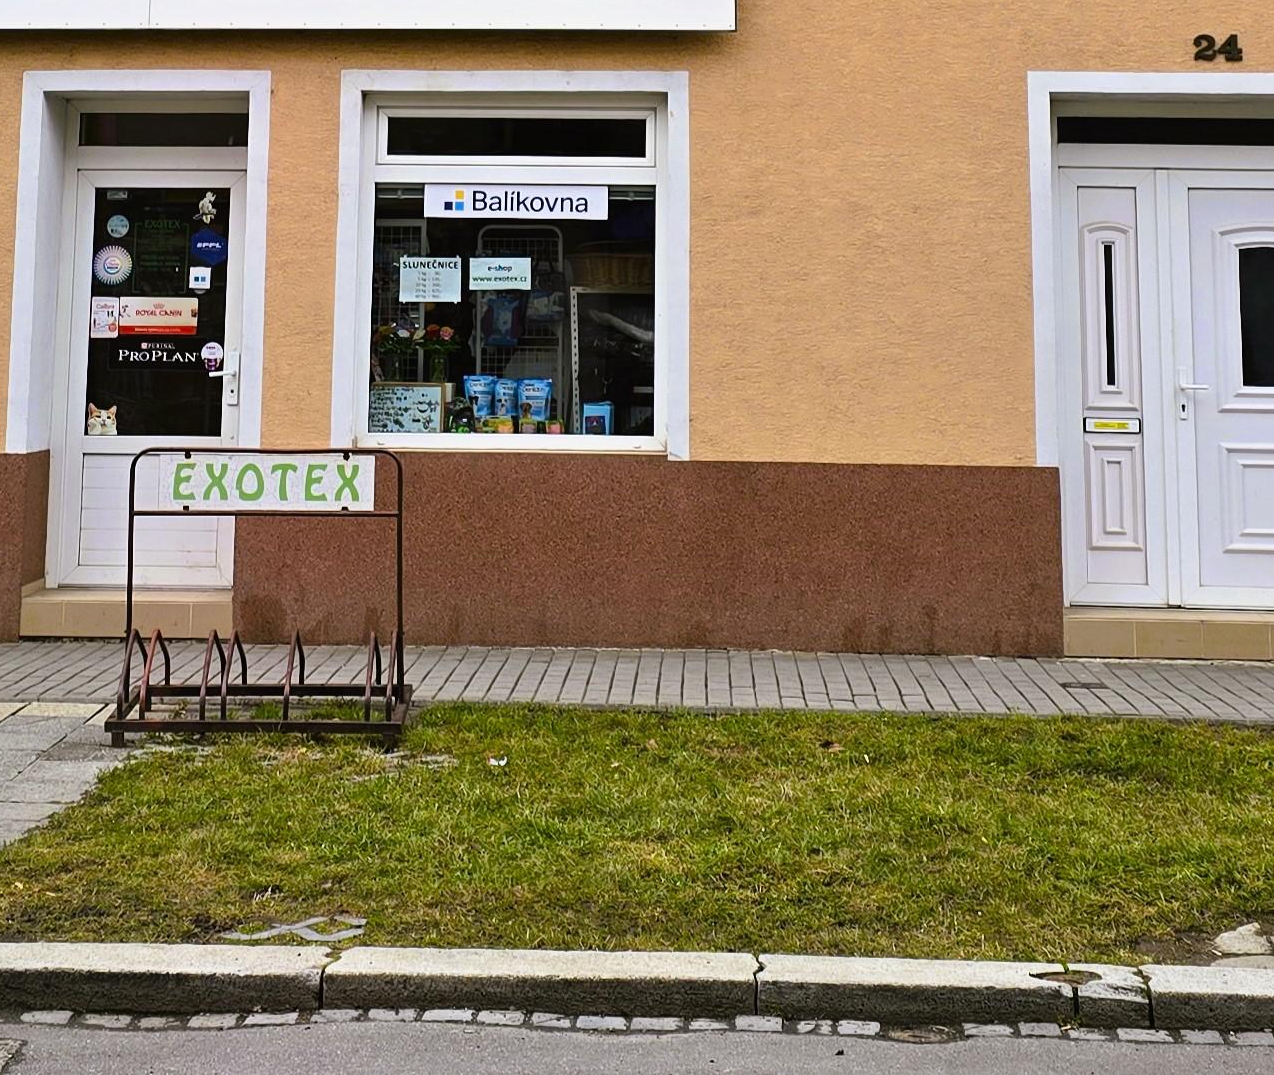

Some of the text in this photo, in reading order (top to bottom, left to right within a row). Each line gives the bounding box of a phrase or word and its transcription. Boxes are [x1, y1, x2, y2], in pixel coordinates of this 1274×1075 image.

[1192, 34, 1243, 63] 24
[472, 190, 588, 213] Balíkovna
[402, 259, 459, 270] SLUNEČNICE
[487, 264, 513, 273] e-shop
[472, 275, 527, 283] www.exotex.cz
[135, 309, 158, 317] ROYAL
[173, 462, 361, 502] EXOTEX
